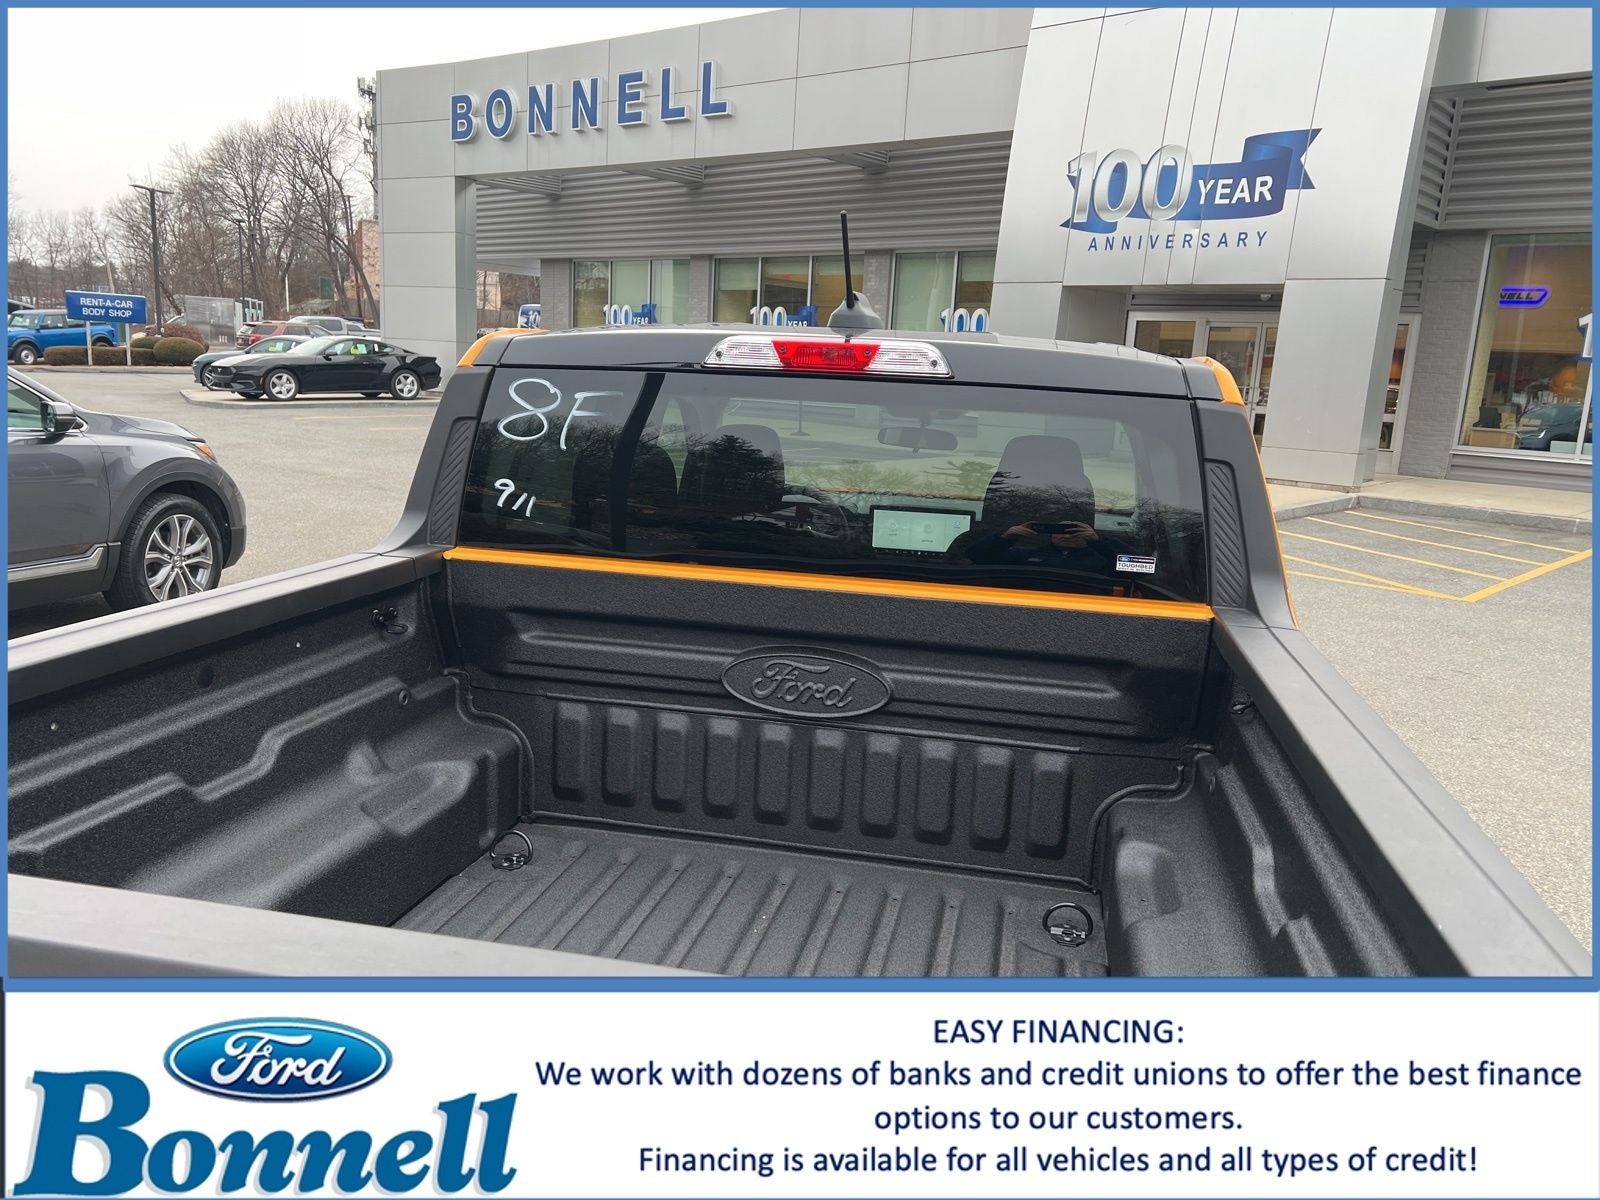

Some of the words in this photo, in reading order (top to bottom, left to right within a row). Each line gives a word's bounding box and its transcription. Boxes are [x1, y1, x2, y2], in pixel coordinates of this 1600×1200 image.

[449, 60, 733, 143] BONNELL
[1066, 144, 1194, 223] 100
[1198, 175, 1273, 205] YEAR
[1087, 230, 1268, 251] ANNIVERSARY
[81, 298, 133, 308] RENT-A-CAR
[82, 308, 105, 316] BODY
[108, 309, 132, 318] SHOP
[603, 304, 632, 325] 100
[633, 316, 649, 325] YEAR
[750, 306, 787, 327] 100
[940, 307, 990, 332] 100
[752, 659, 857, 708] Ford
